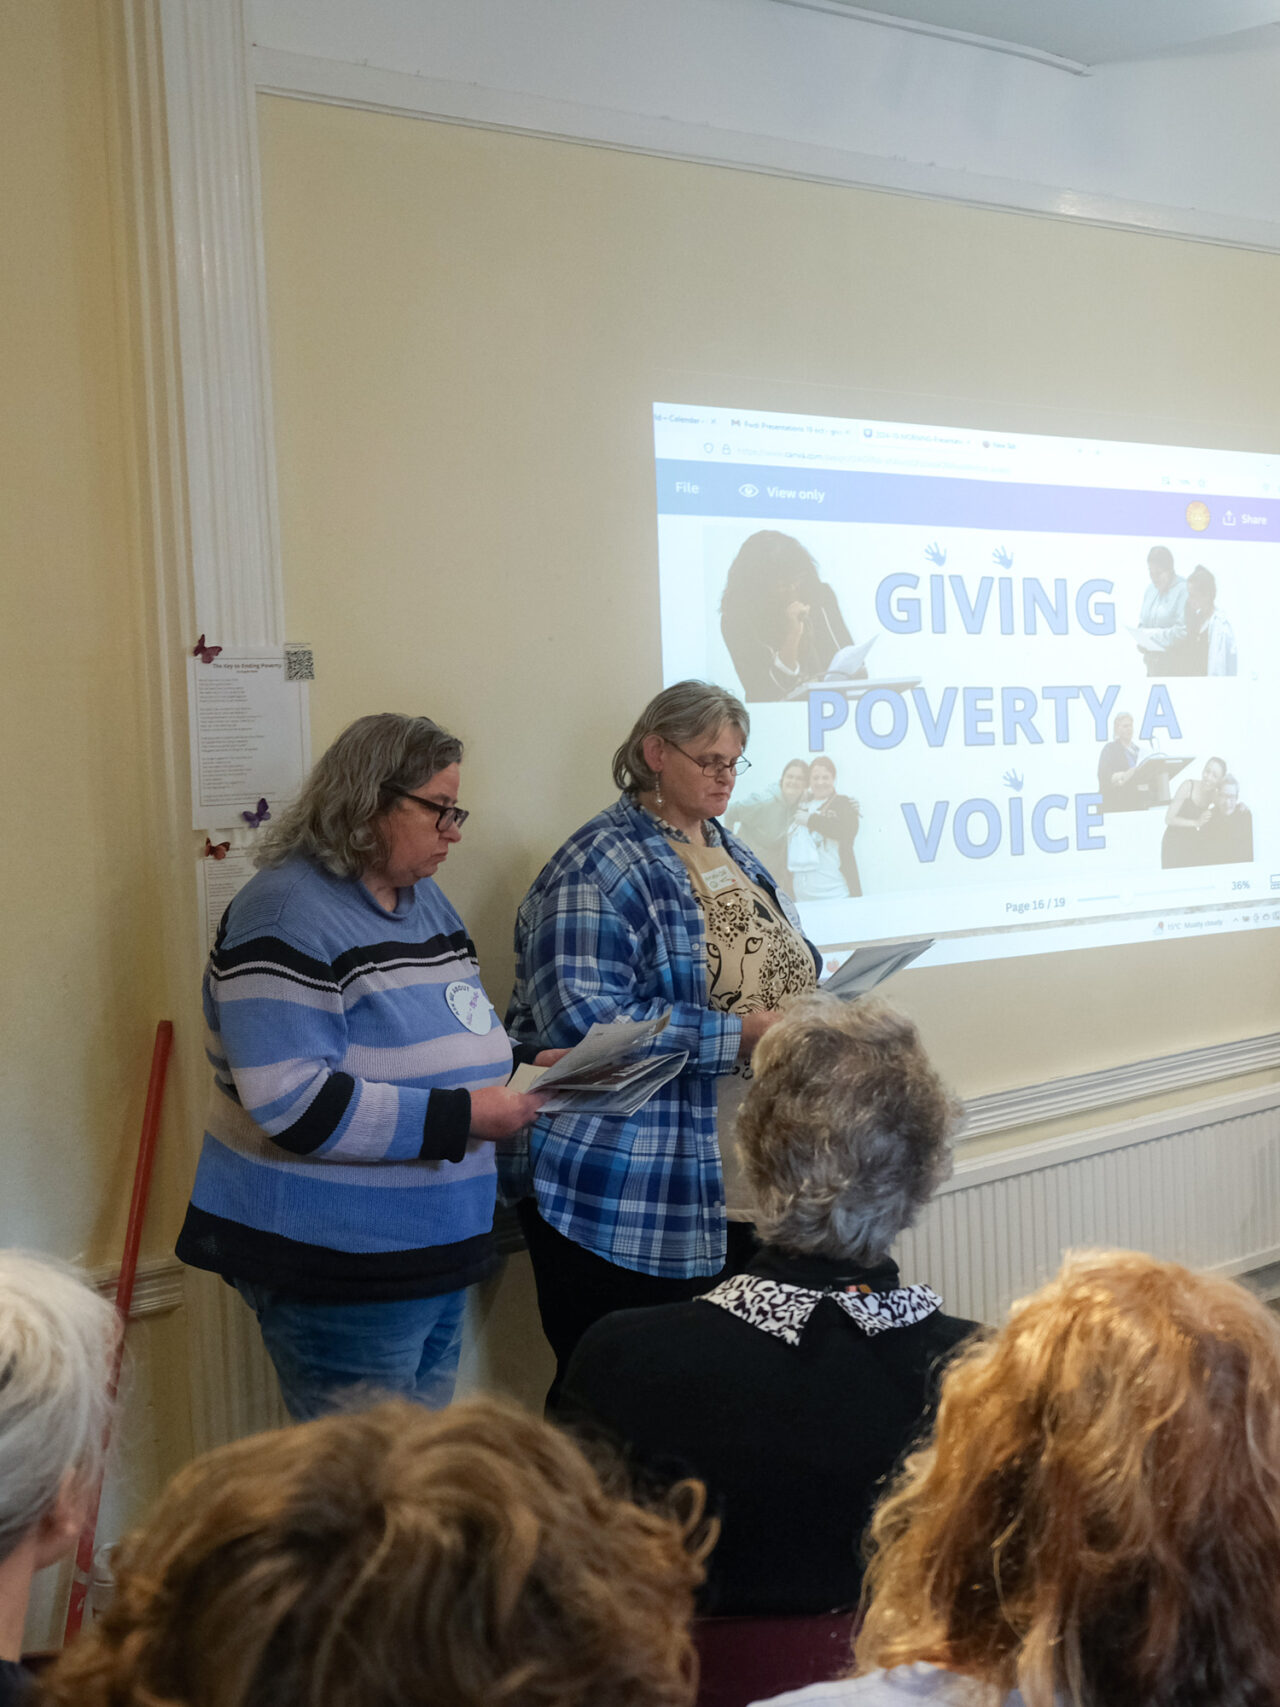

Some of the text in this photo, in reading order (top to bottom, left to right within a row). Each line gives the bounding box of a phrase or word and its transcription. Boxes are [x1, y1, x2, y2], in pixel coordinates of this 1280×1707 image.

[674, 481, 700, 495] File
[766, 486, 826, 504] View only
[1241, 513, 1268, 527] Share
[875, 572, 1117, 637] GIVING
[808, 683, 1183, 753] POVERTY A
[901, 792, 1107, 863] VOICE
[1231, 880, 1250, 891] 36%
[1005, 902, 1030, 915] Page
[1032, 899, 1045, 911] 16
[1054, 897, 1066, 908] 19
